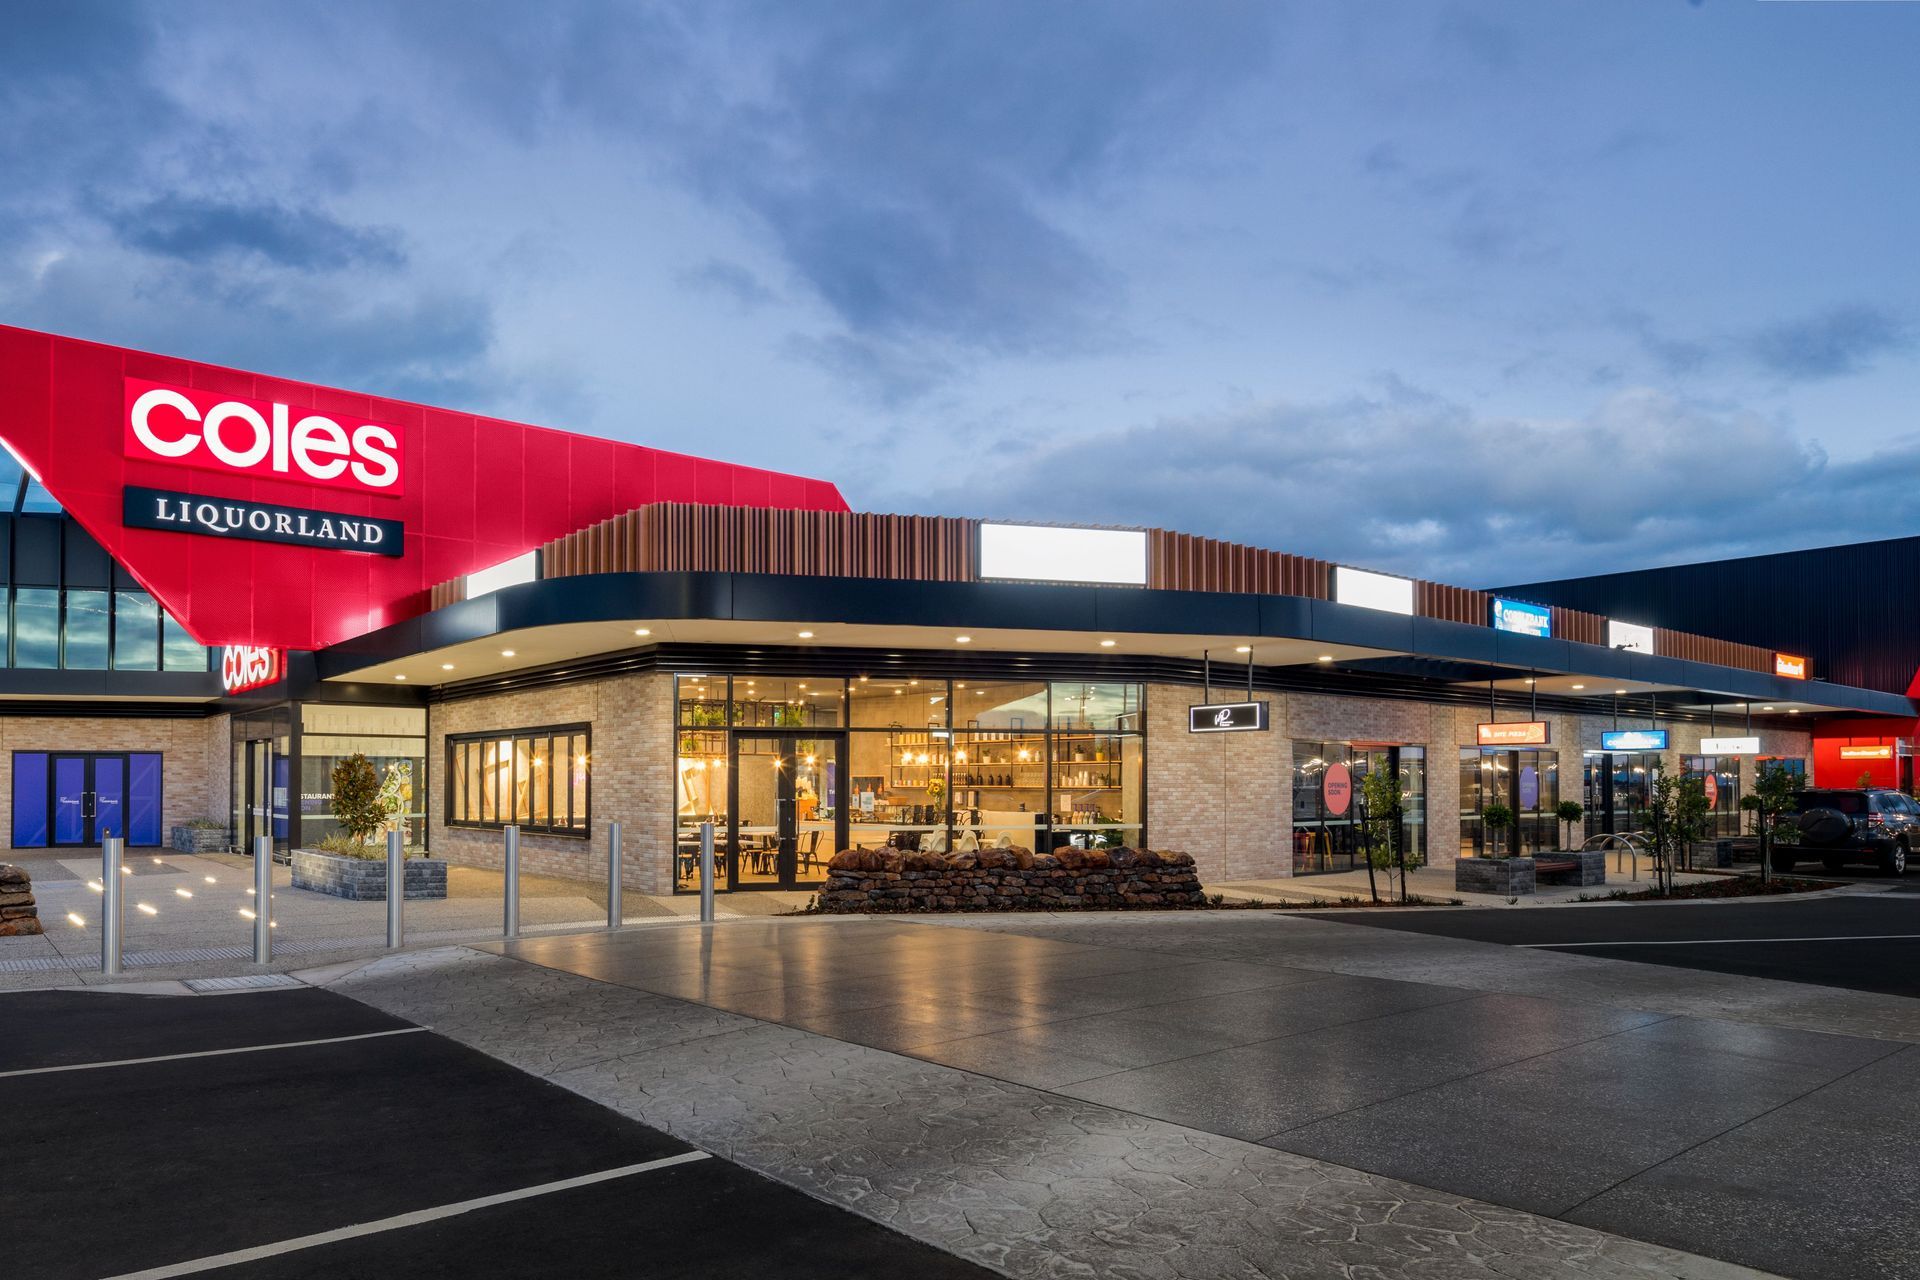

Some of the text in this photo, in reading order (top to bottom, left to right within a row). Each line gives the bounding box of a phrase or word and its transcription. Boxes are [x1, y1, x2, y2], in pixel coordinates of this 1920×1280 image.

[131, 389, 399, 487] coles
[156, 498, 383, 544] LIQUORLAND
[223, 645, 270, 690] coles
